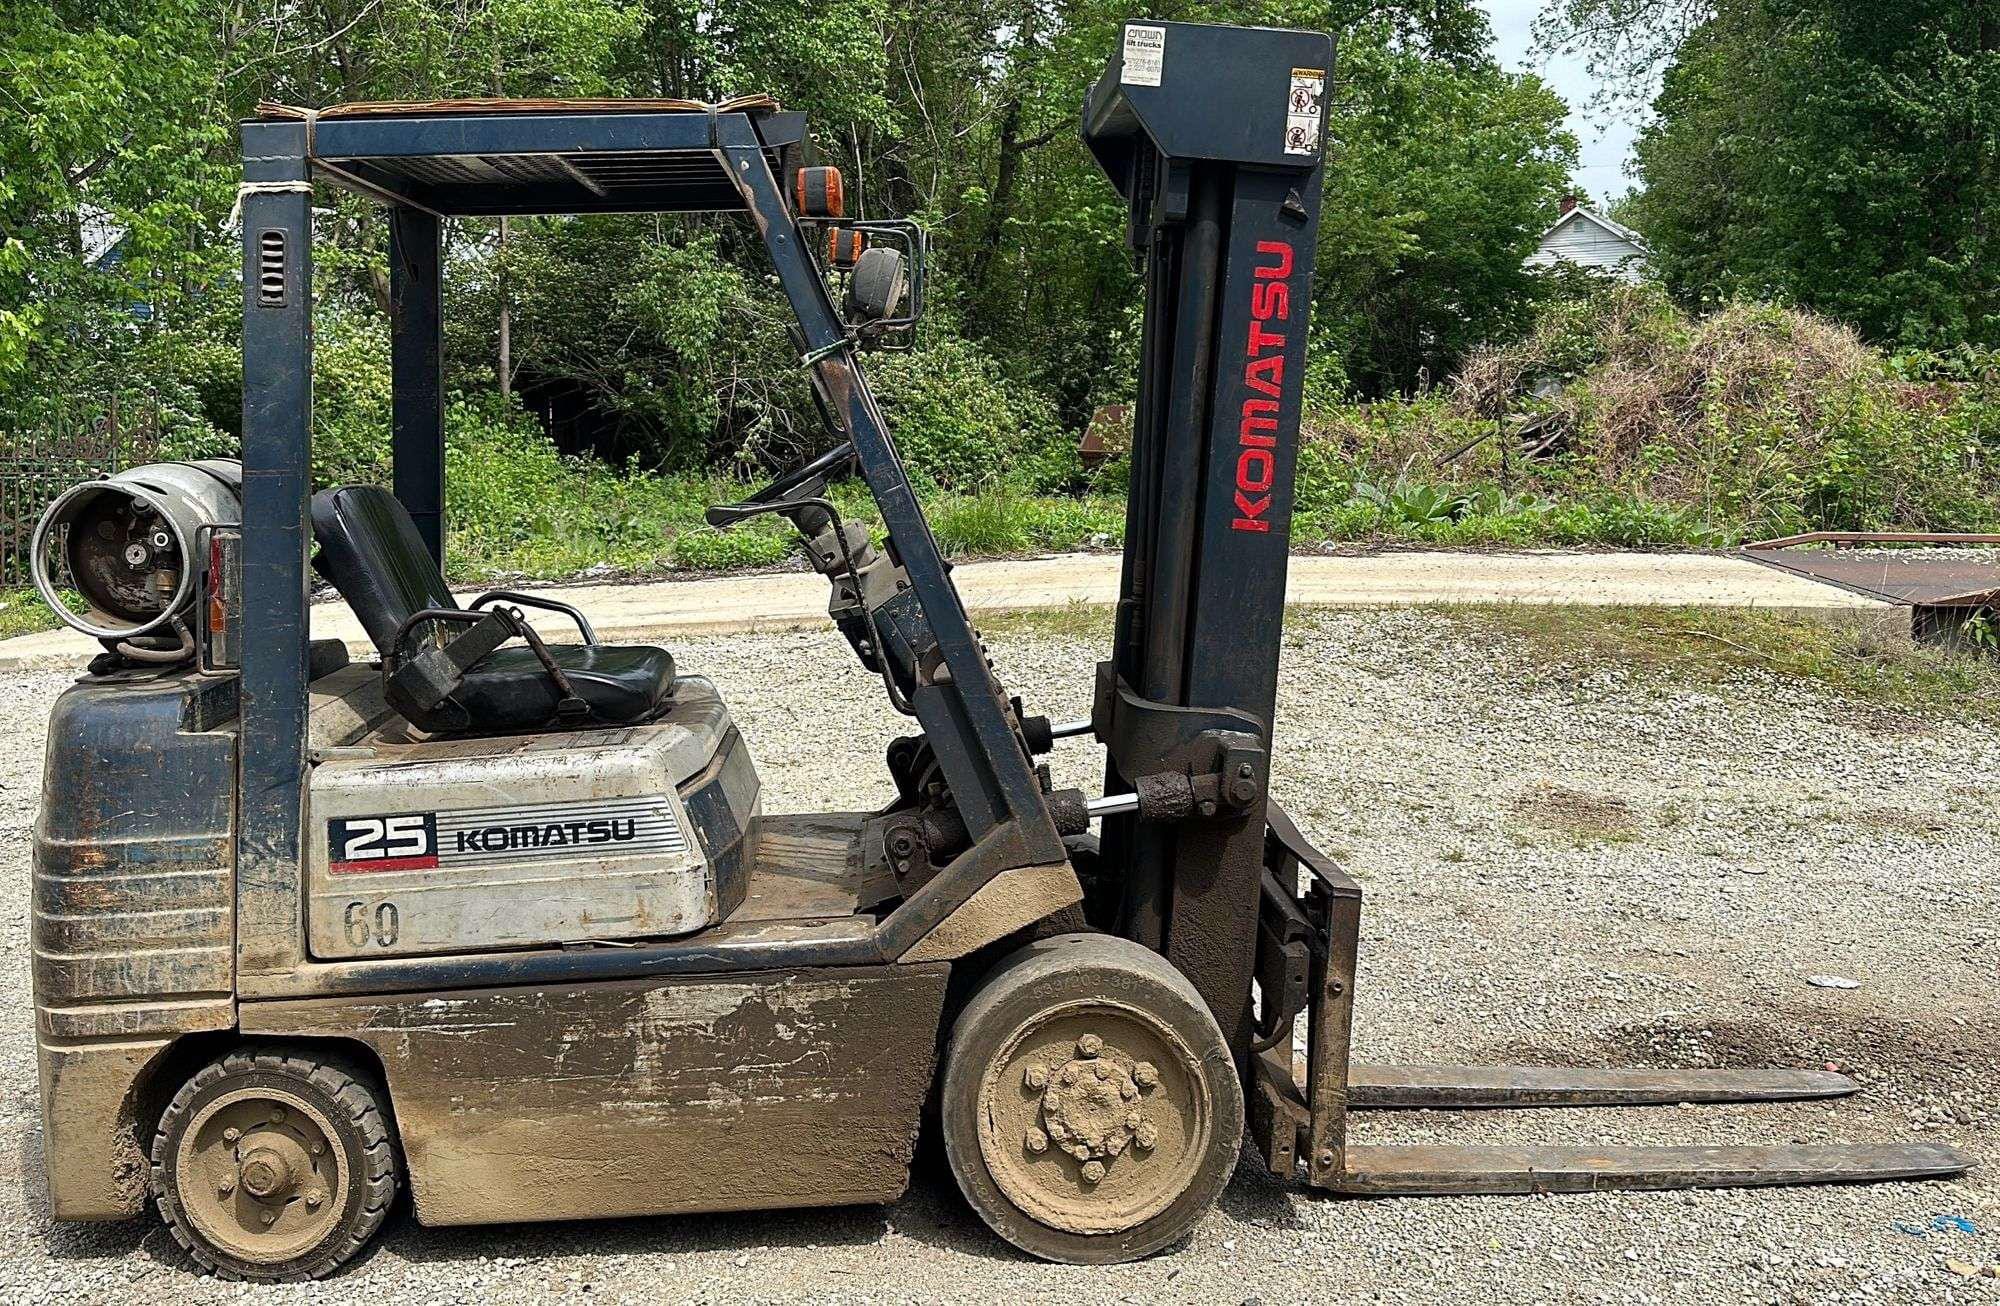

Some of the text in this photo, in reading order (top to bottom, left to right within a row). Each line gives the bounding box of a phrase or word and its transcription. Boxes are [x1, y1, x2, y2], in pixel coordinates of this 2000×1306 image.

[1126, 39, 1162, 49] lift trucks
[1231, 240, 1294, 533] KOMATSU
[344, 815, 636, 861] 25 KOMATSU
[344, 901, 400, 948] 60
